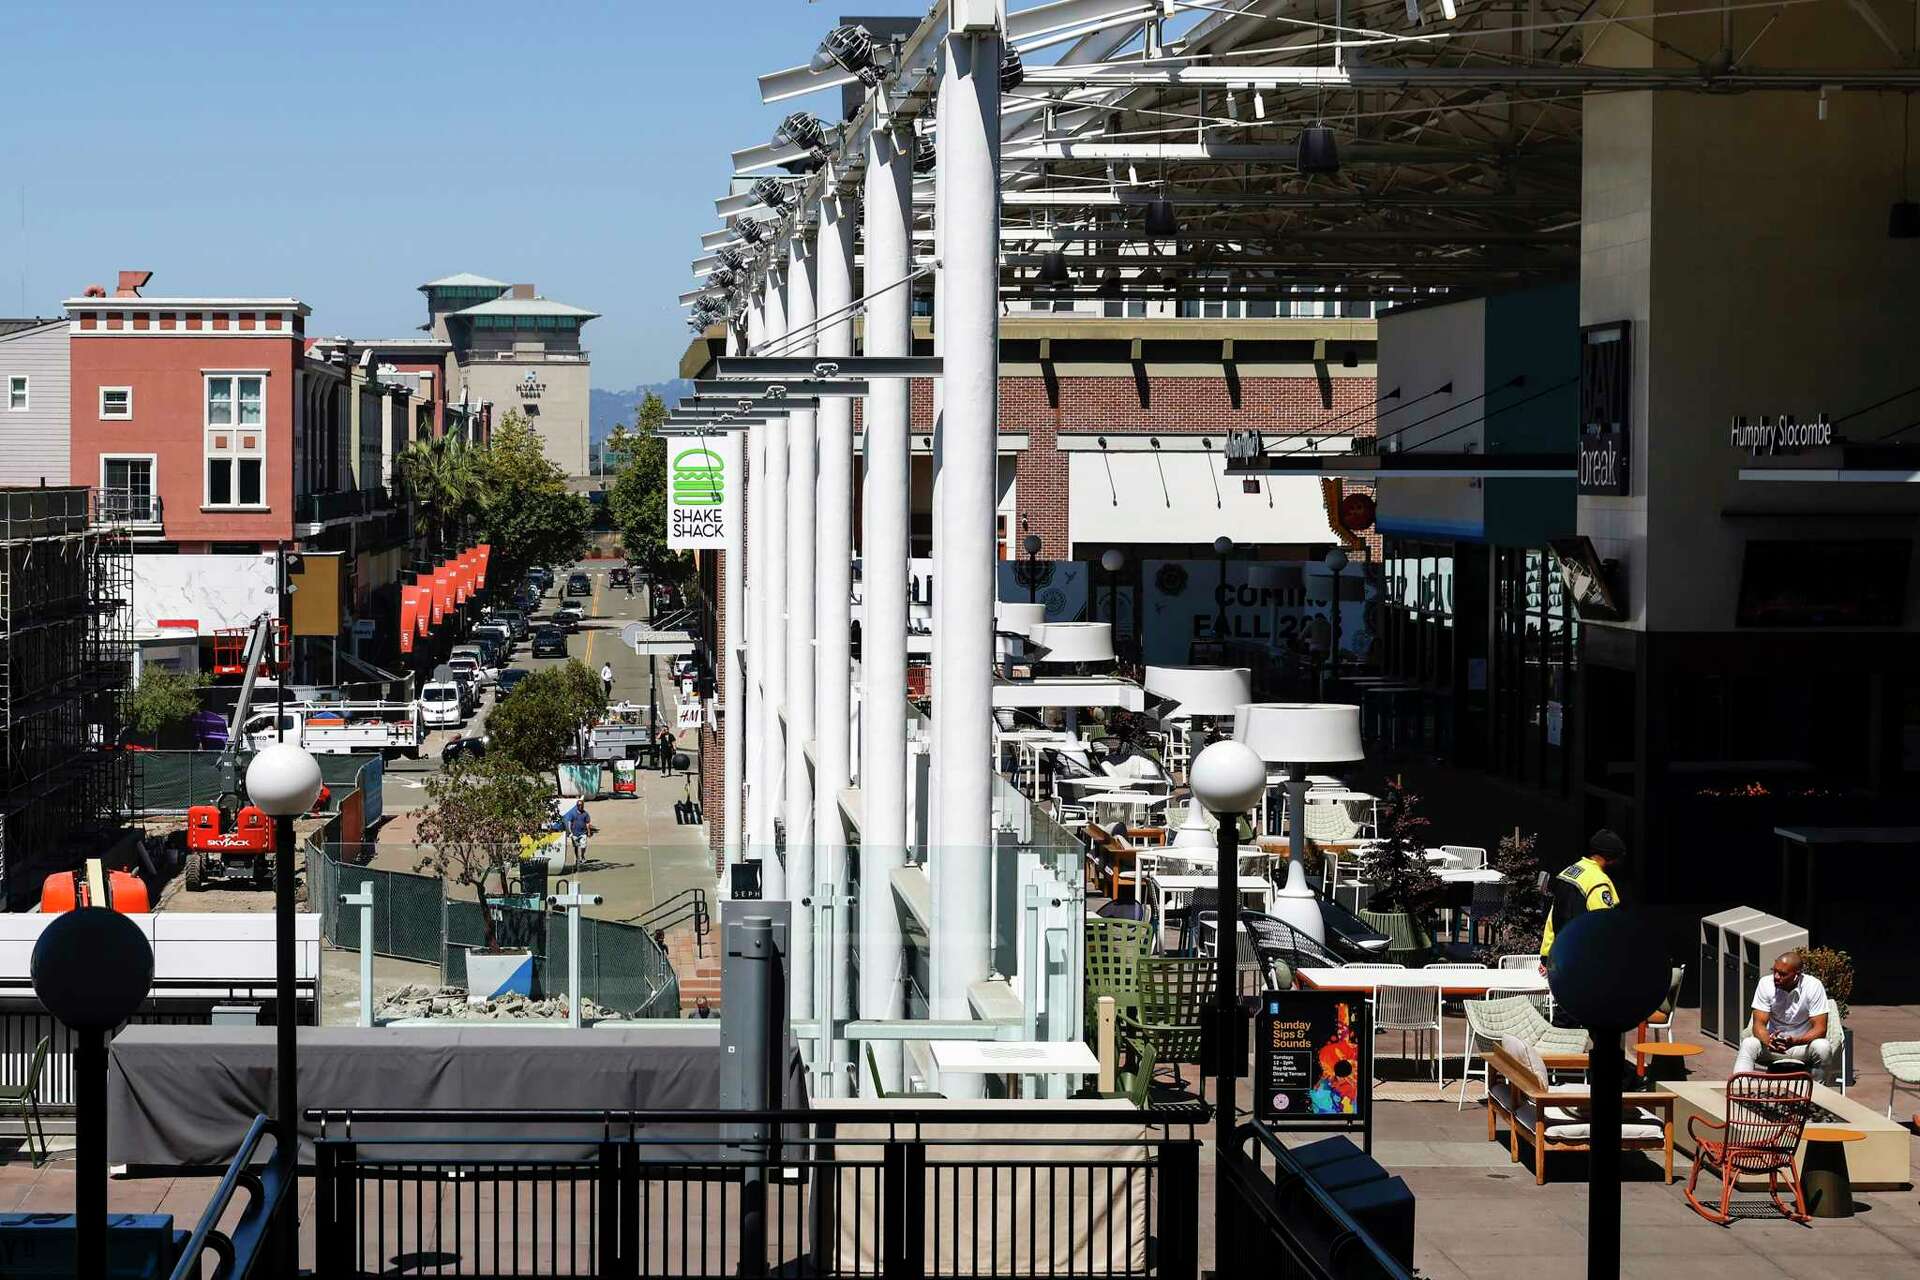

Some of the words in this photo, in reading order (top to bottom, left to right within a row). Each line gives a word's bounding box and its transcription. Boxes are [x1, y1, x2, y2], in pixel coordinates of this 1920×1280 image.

[1730, 415, 1776, 456] Humphry
[1779, 412, 1831, 446] Slocombe
[1580, 440, 1617, 486] break
[673, 509, 723, 523] SHAKE
[673, 523, 725, 538] SHACK
[1194, 614, 1270, 638] FALL
[207, 839, 250, 847] SKYJACK
[1273, 1020, 1312, 1031] Sunday
[1273, 1030, 1295, 1040] Sips
[1297, 1030, 1305, 1039] &
[1273, 1039, 1312, 1048] Sounds
